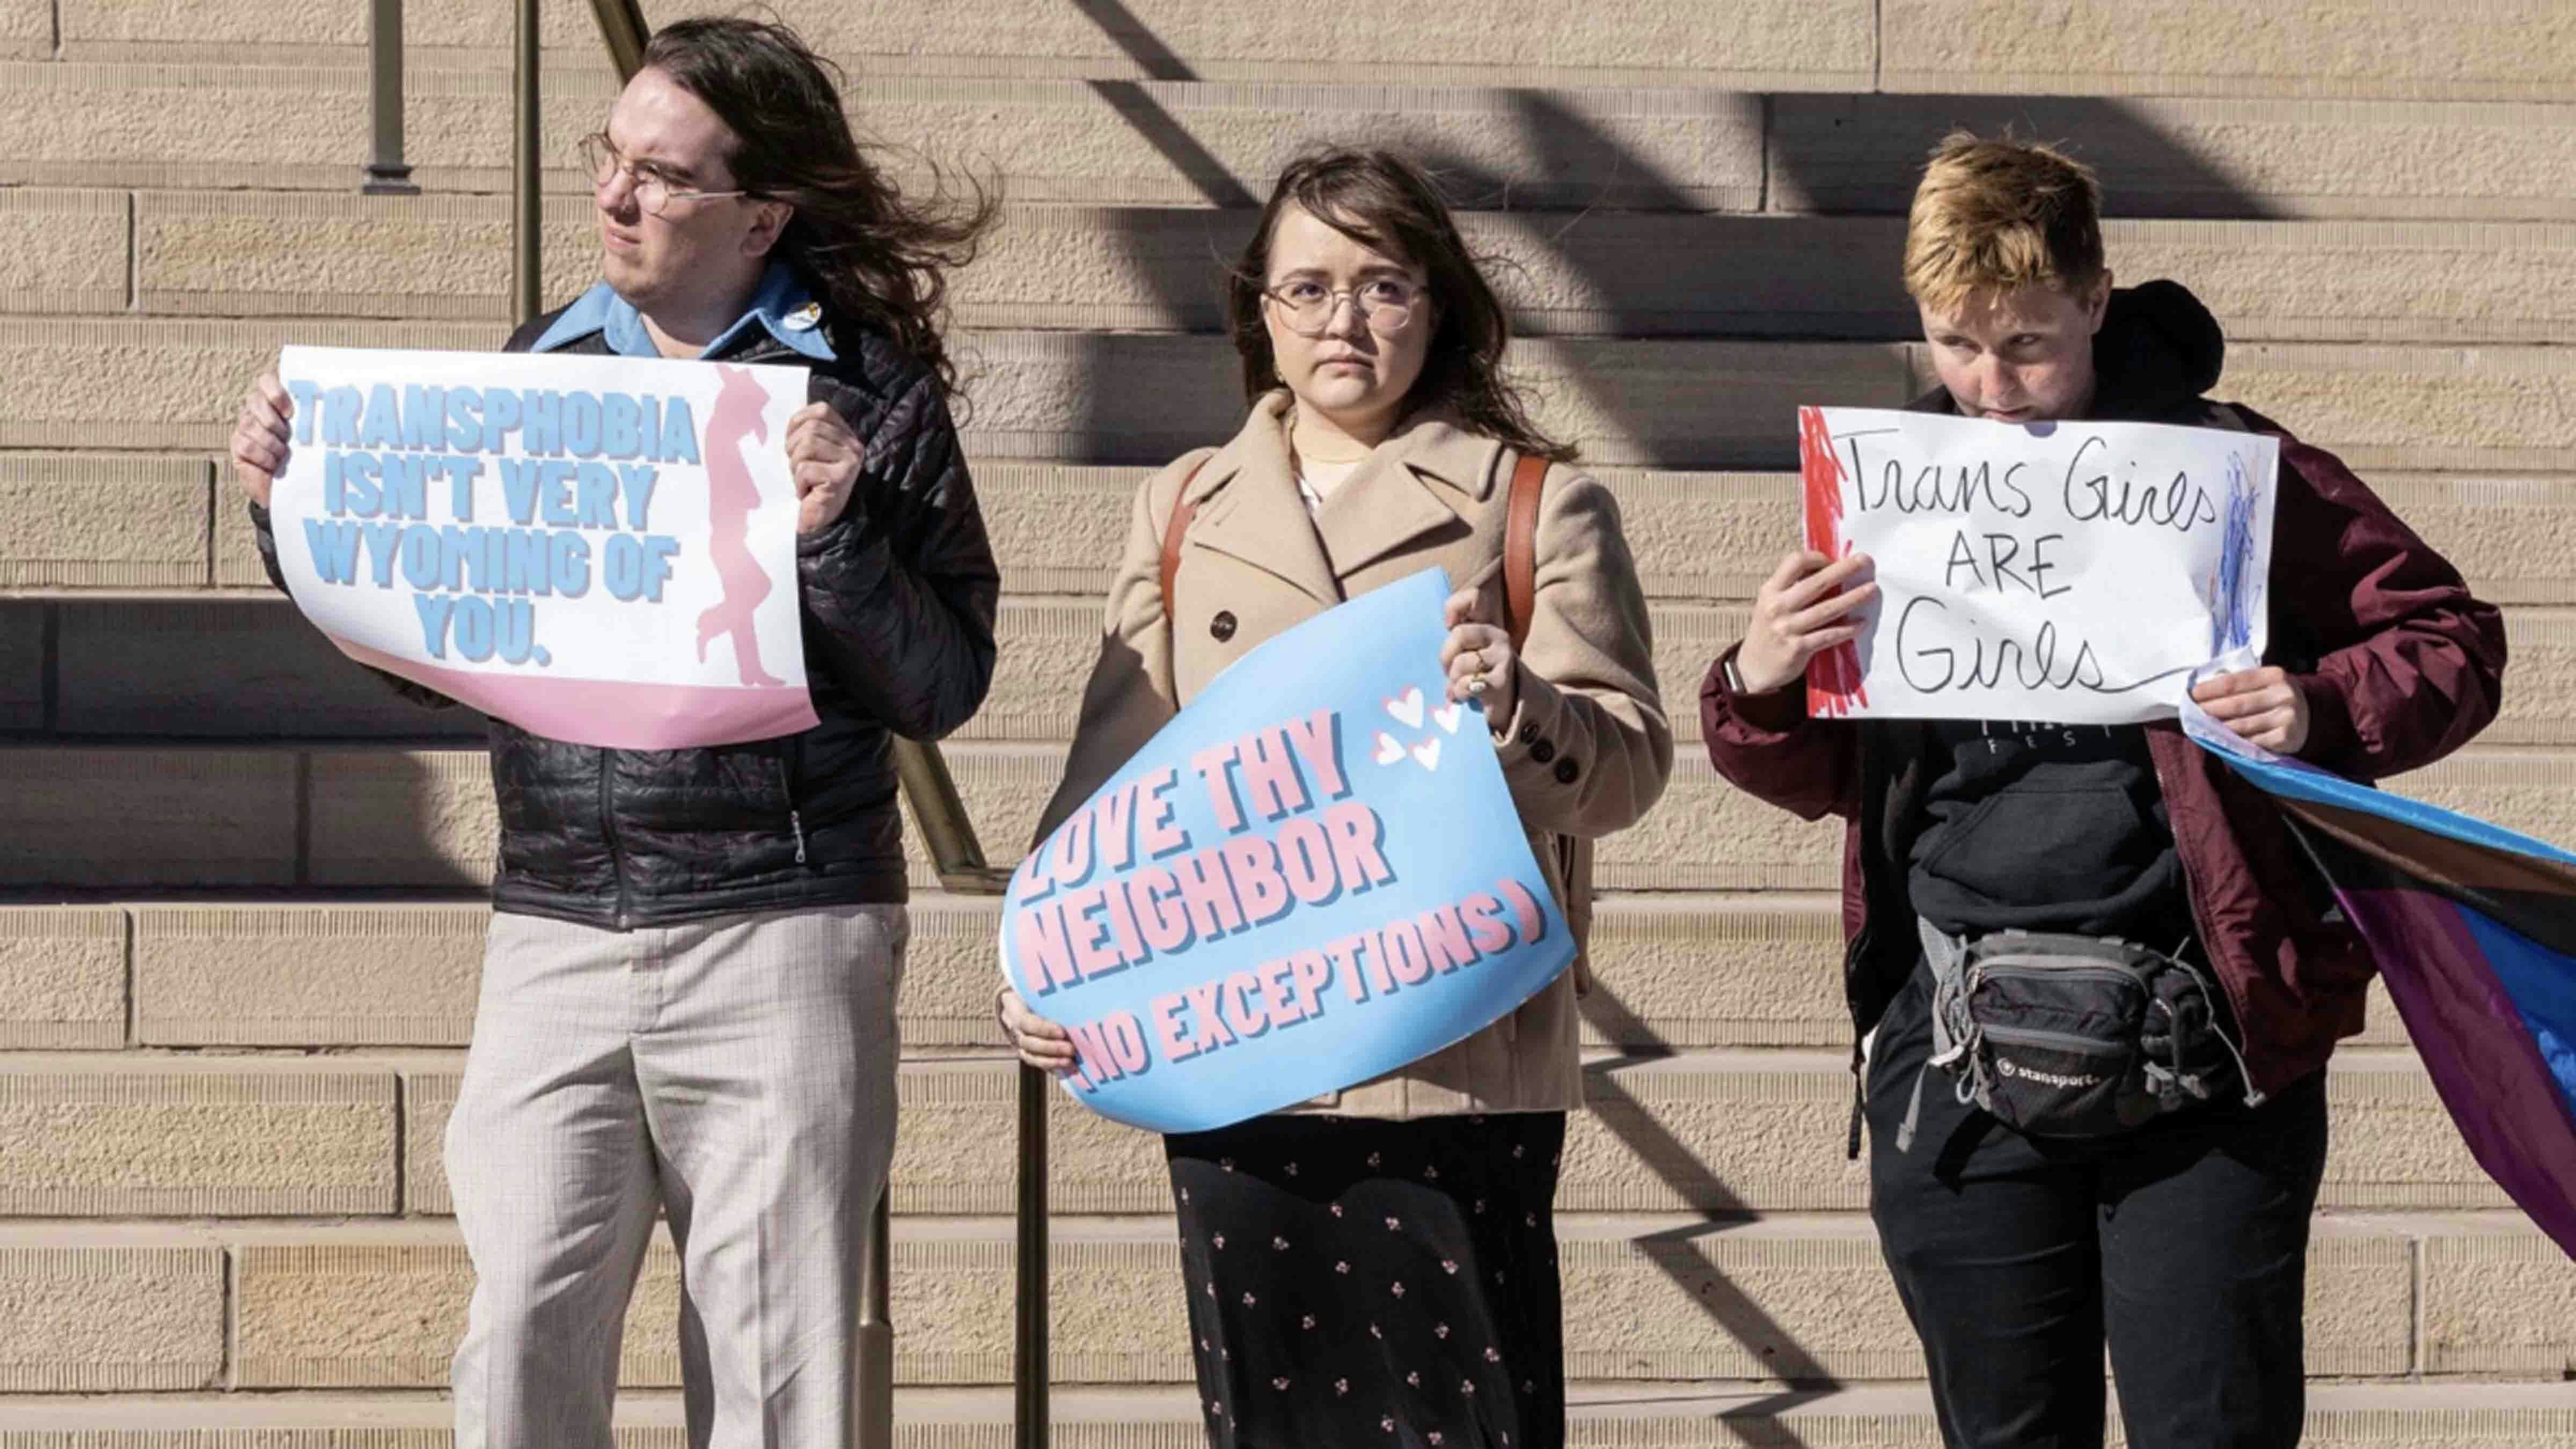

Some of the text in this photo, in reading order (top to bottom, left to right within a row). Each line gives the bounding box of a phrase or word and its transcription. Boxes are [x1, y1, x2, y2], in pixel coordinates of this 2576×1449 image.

[290, 382, 699, 463] TRANSPHOBIA
[325, 452, 658, 529] ISN'T VERY
[1832, 429, 2215, 531] Trans Girls
[304, 519, 680, 603] WYOMING OF
[1945, 530, 2072, 599] ARE
[414, 593, 552, 667] YOU.
[1897, 596, 2197, 693] Girls
[1020, 711, 1351, 904] LOVE THY
[1016, 802, 1397, 997] NEIGHBOR
[1151, 880, 1546, 1061] EXCEPTIONS)
